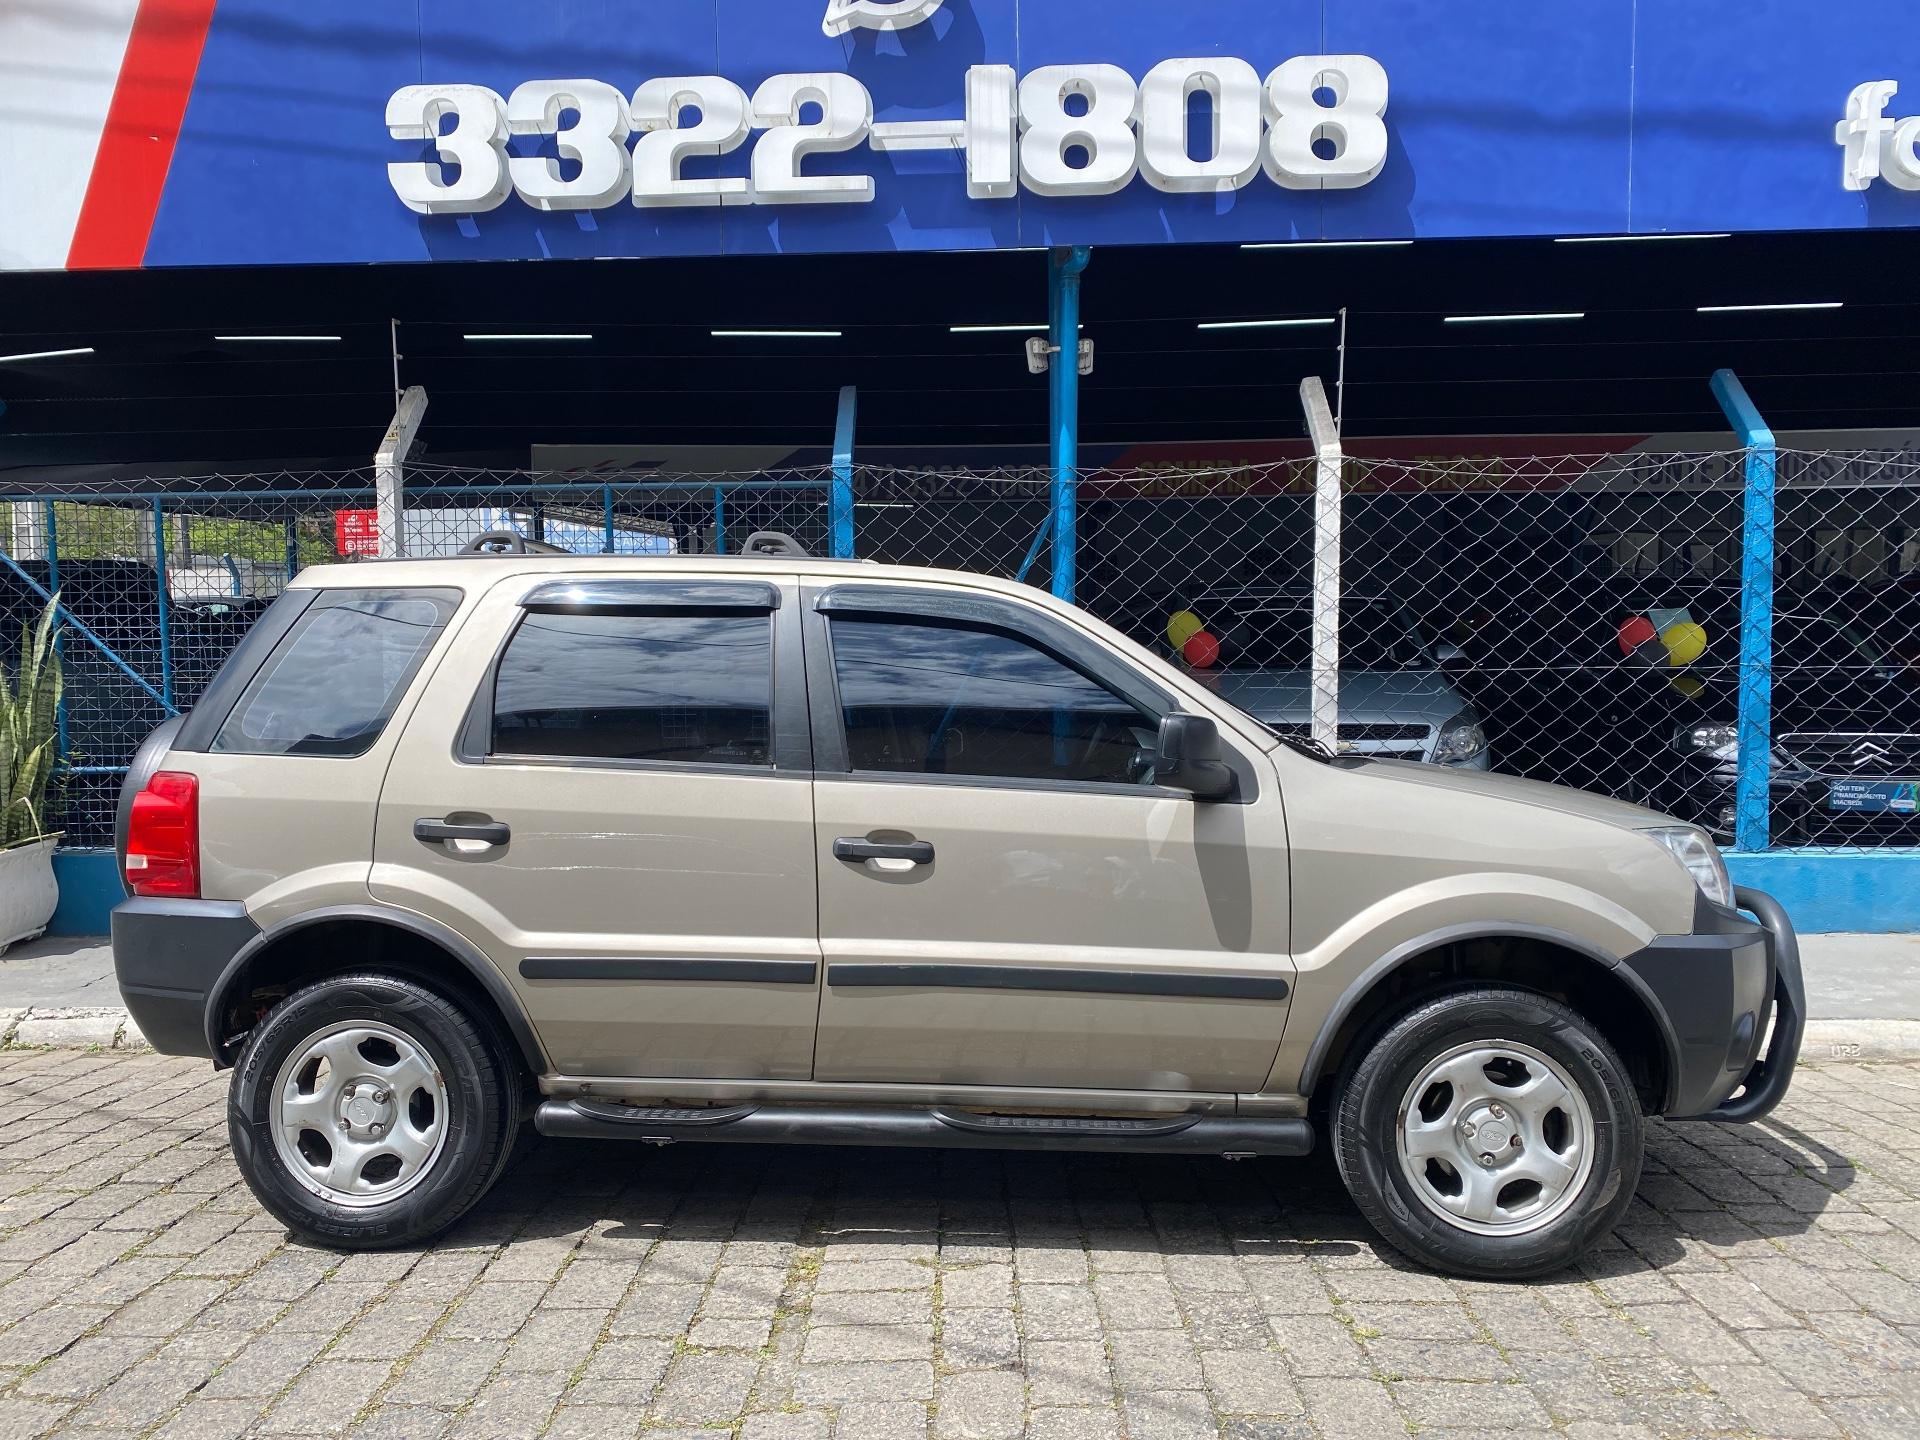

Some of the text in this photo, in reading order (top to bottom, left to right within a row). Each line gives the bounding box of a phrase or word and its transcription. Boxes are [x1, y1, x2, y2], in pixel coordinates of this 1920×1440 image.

[386, 54, 1390, 214] 3322-1808
[1137, 460, 1253, 496] COMPRA
[1287, 456, 1376, 492] VEDE
